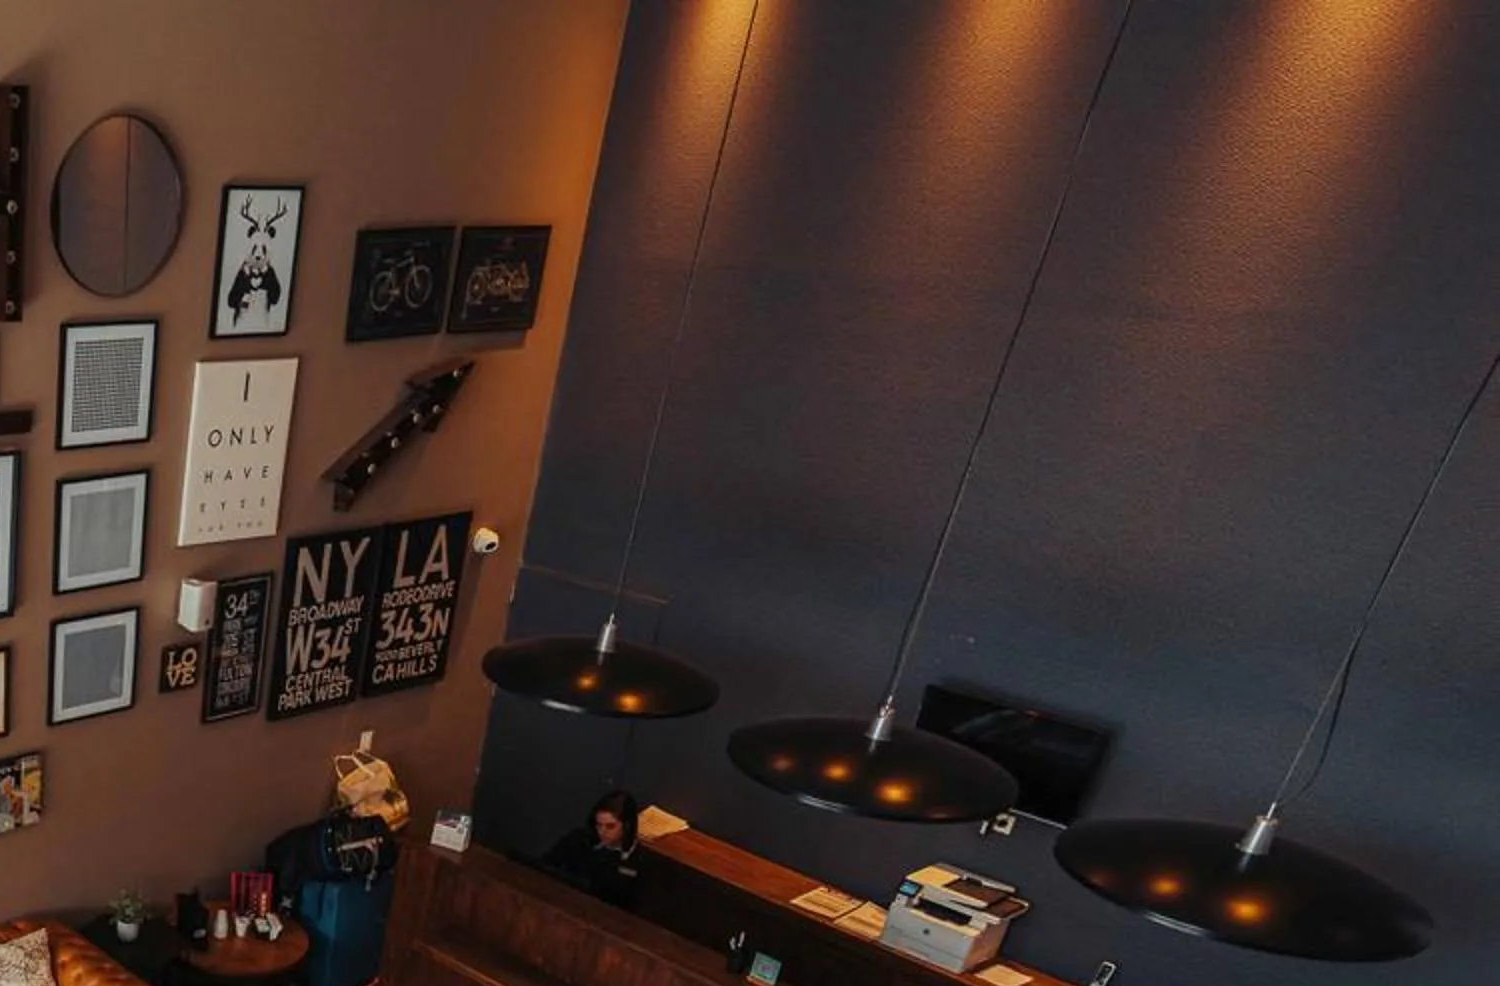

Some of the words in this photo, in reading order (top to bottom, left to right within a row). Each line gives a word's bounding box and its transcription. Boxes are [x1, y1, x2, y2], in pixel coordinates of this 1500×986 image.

[243, 371, 251, 402] I
[207, 425, 275, 448] ONLY
[204, 465, 270, 483] HAVE
[393, 524, 450, 588] LA
[293, 536, 371, 607] NY
[288, 595, 365, 626] BROADWAY
[285, 664, 353, 693] CENTRAL
[313, 680, 353, 704] WEST
